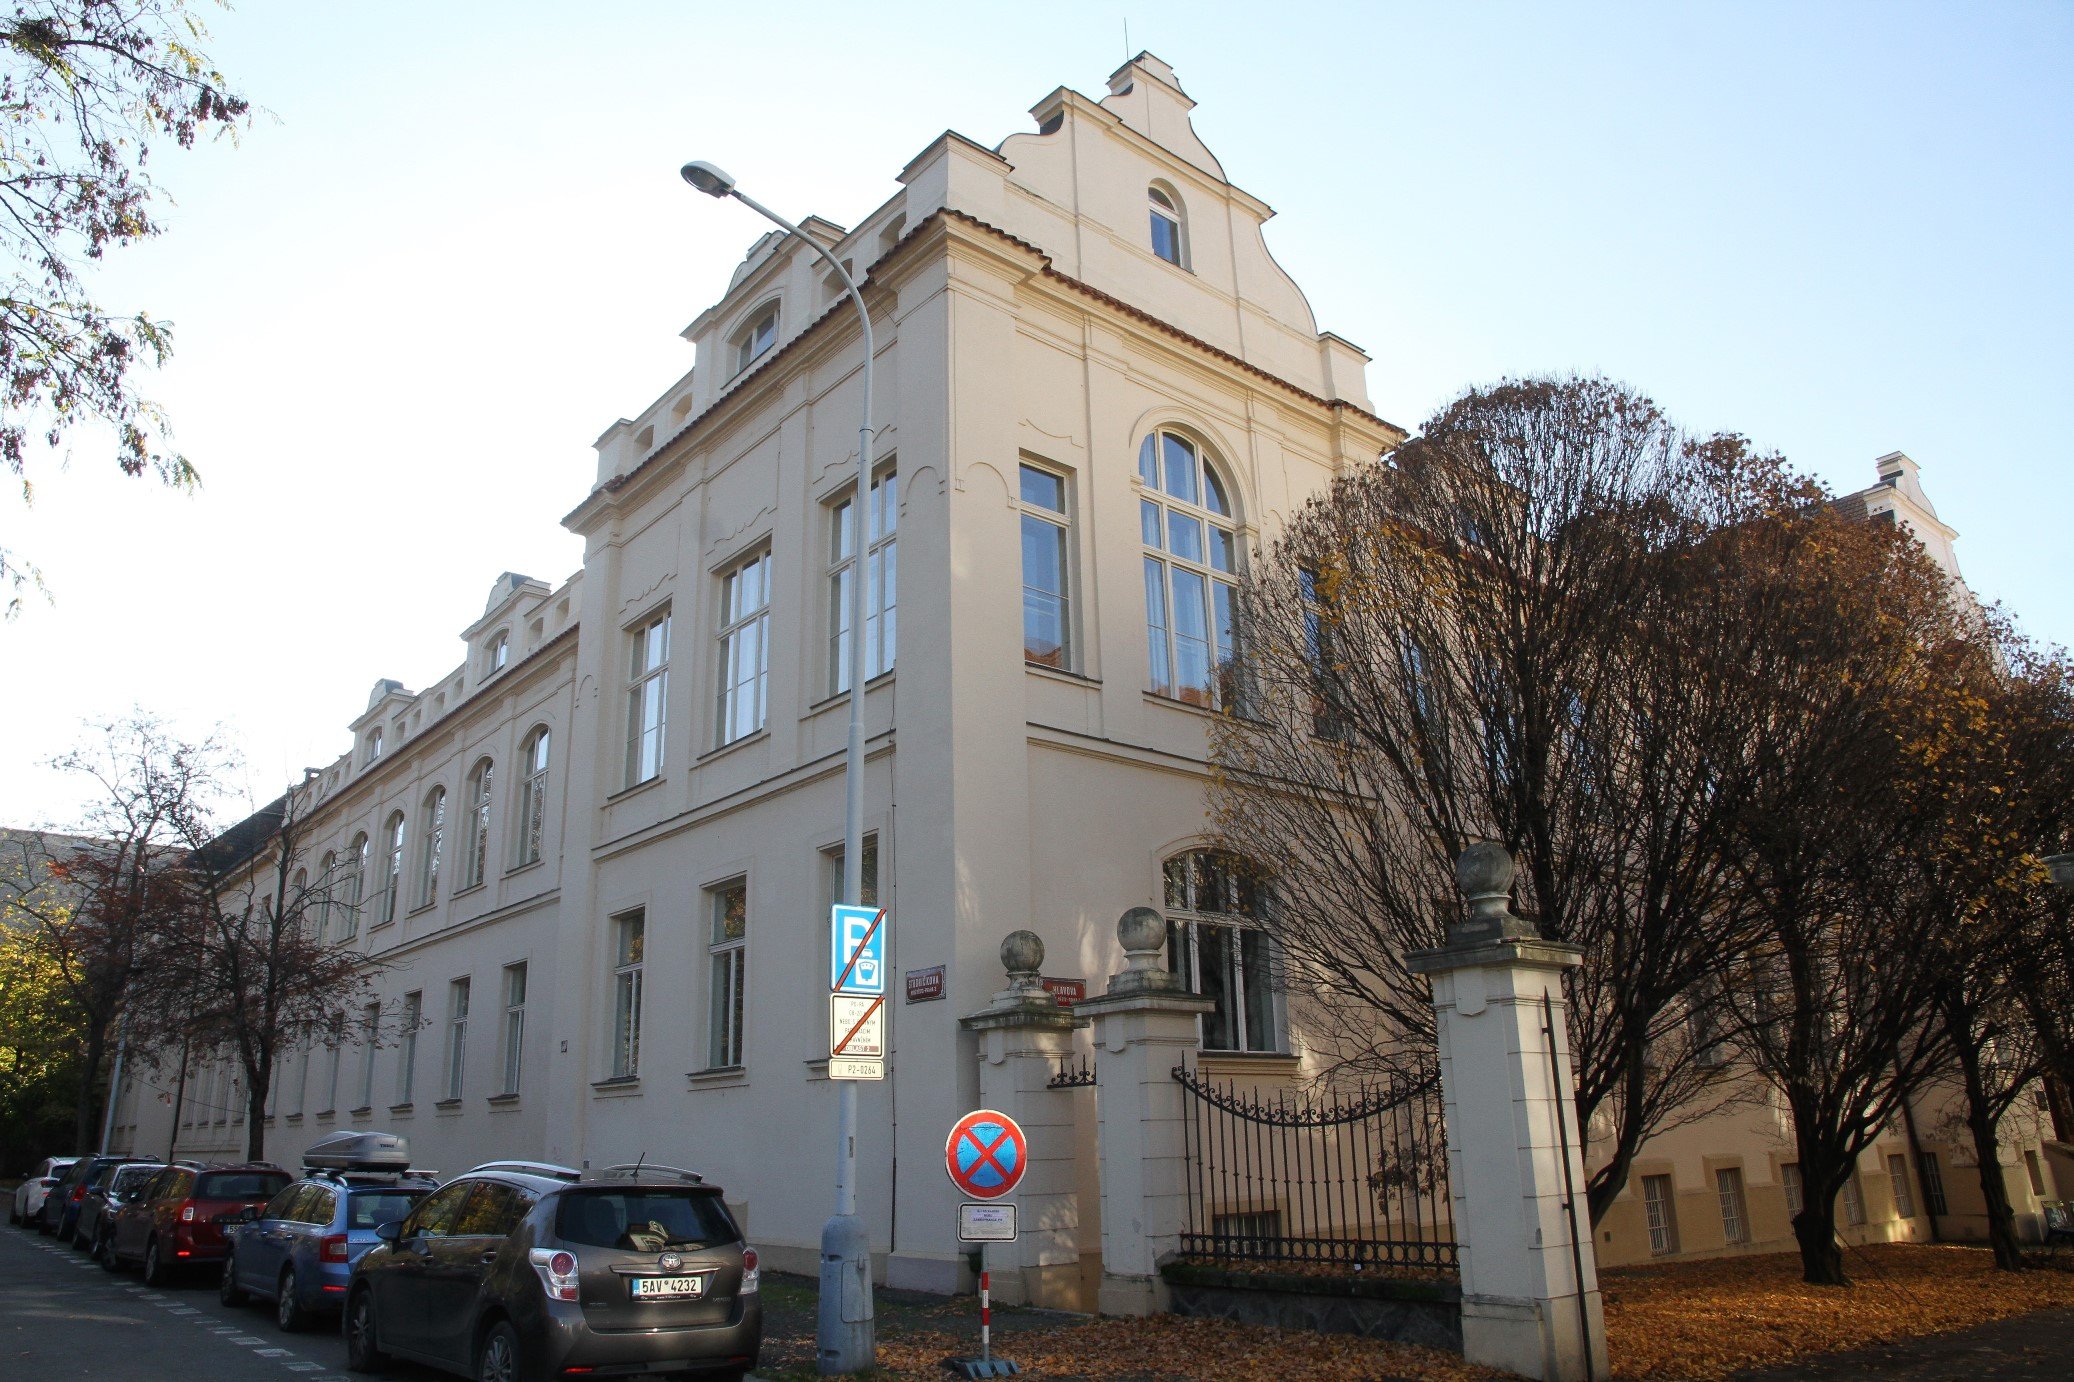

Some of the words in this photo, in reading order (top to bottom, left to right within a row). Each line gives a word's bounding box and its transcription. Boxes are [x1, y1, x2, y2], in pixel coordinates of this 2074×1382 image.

[843, 916, 874, 964] P
[642, 1280, 662, 1293] 5AV
[671, 1279, 697, 1292] 4232
